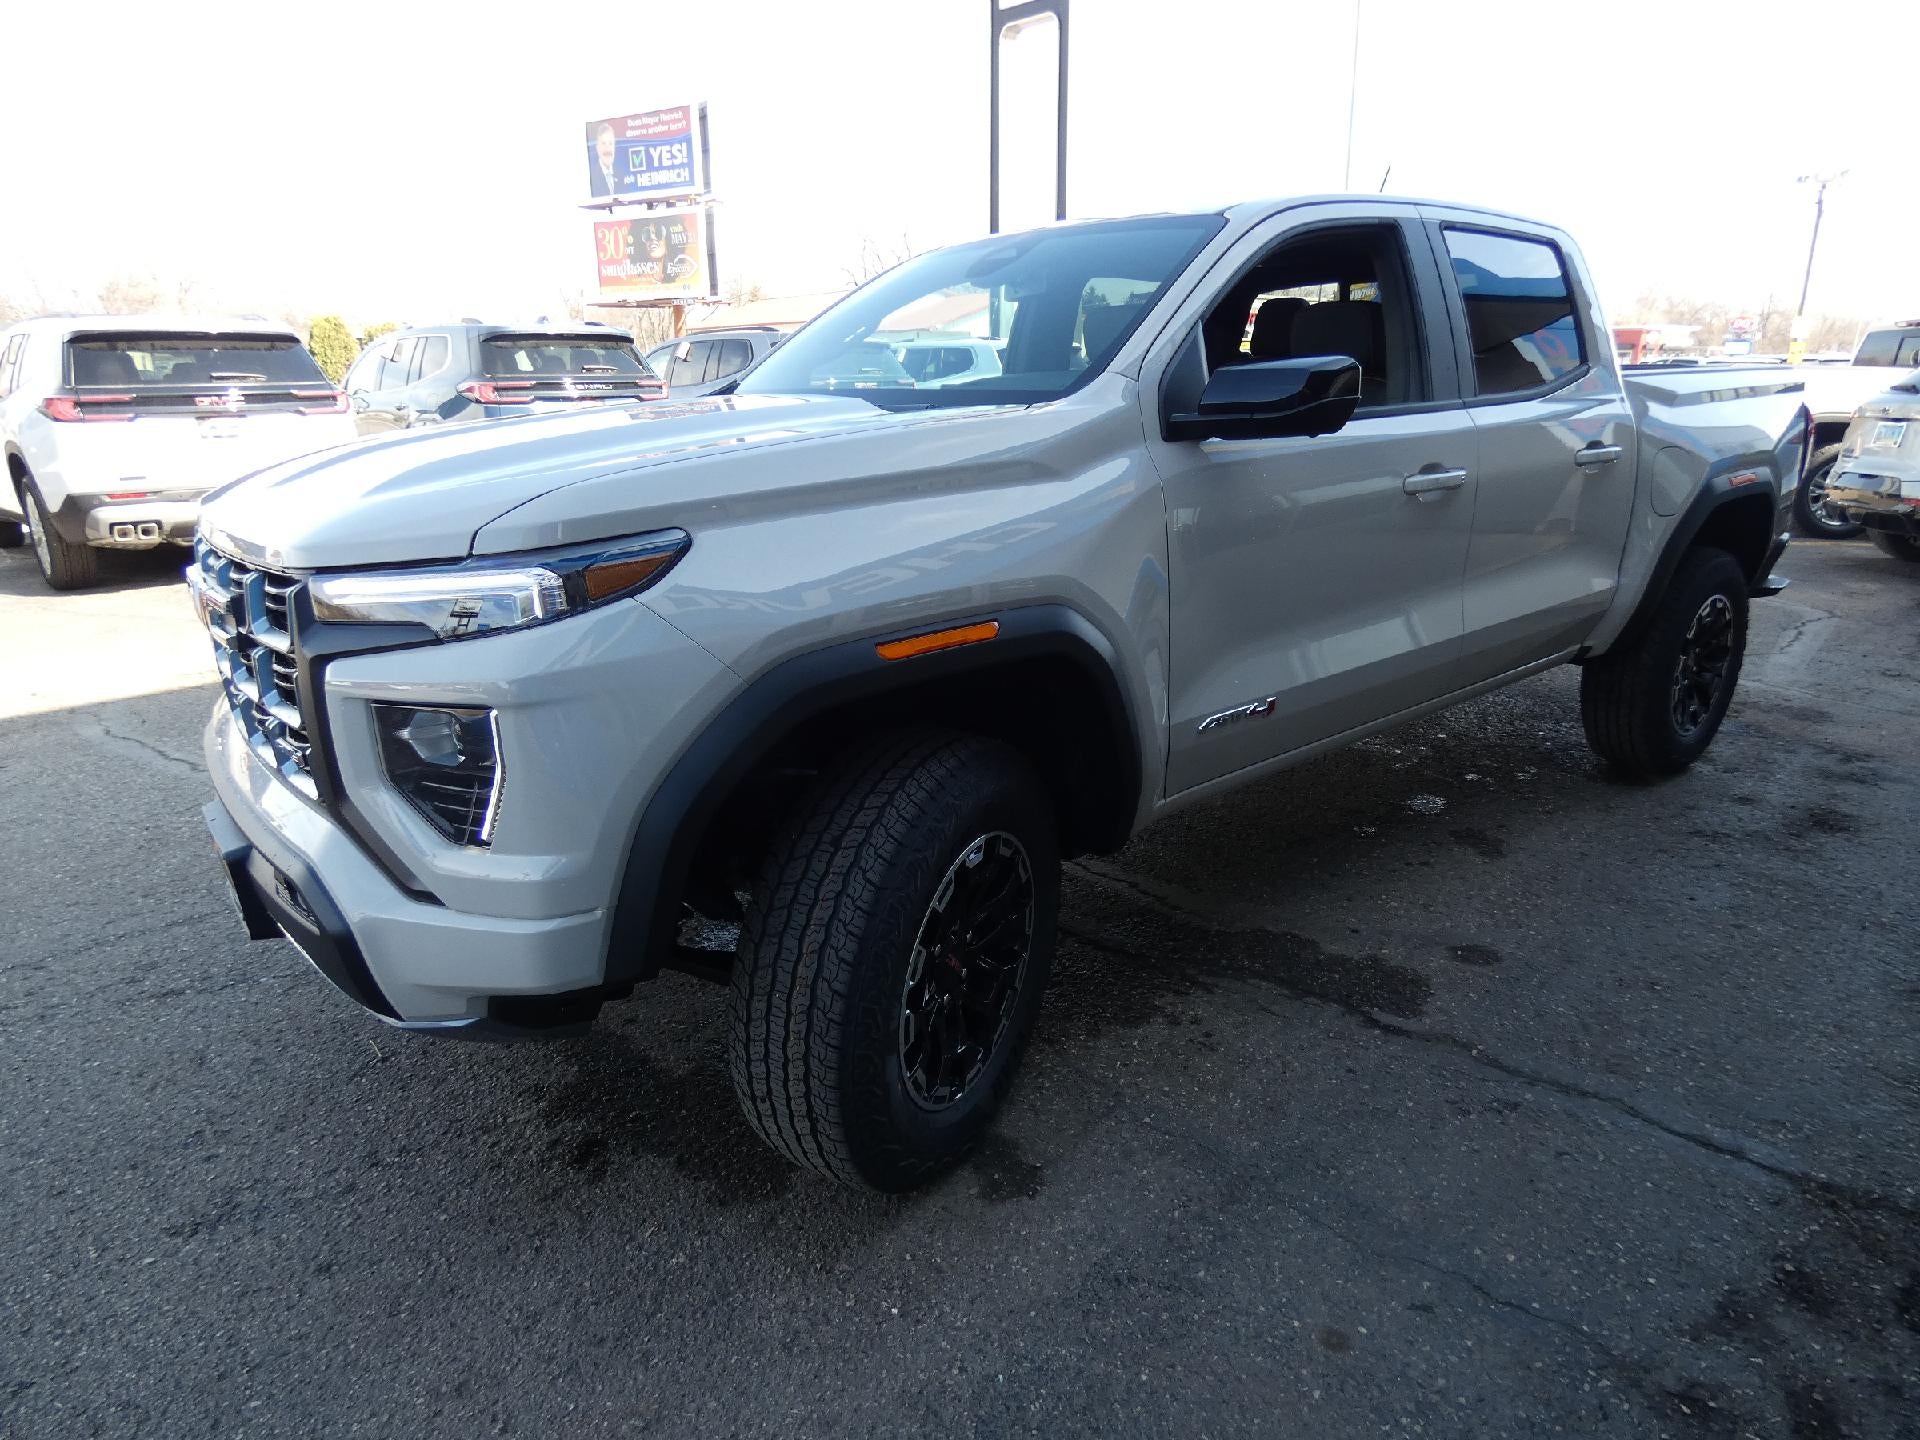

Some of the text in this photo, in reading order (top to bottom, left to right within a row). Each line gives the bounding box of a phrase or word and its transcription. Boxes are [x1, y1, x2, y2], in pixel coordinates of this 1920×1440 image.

[642, 116, 659, 125] Mayor
[647, 125, 669, 134] another
[649, 142, 688, 167] YES!
[637, 168, 689, 187] HEINRICH
[671, 232, 688, 244] MAY
